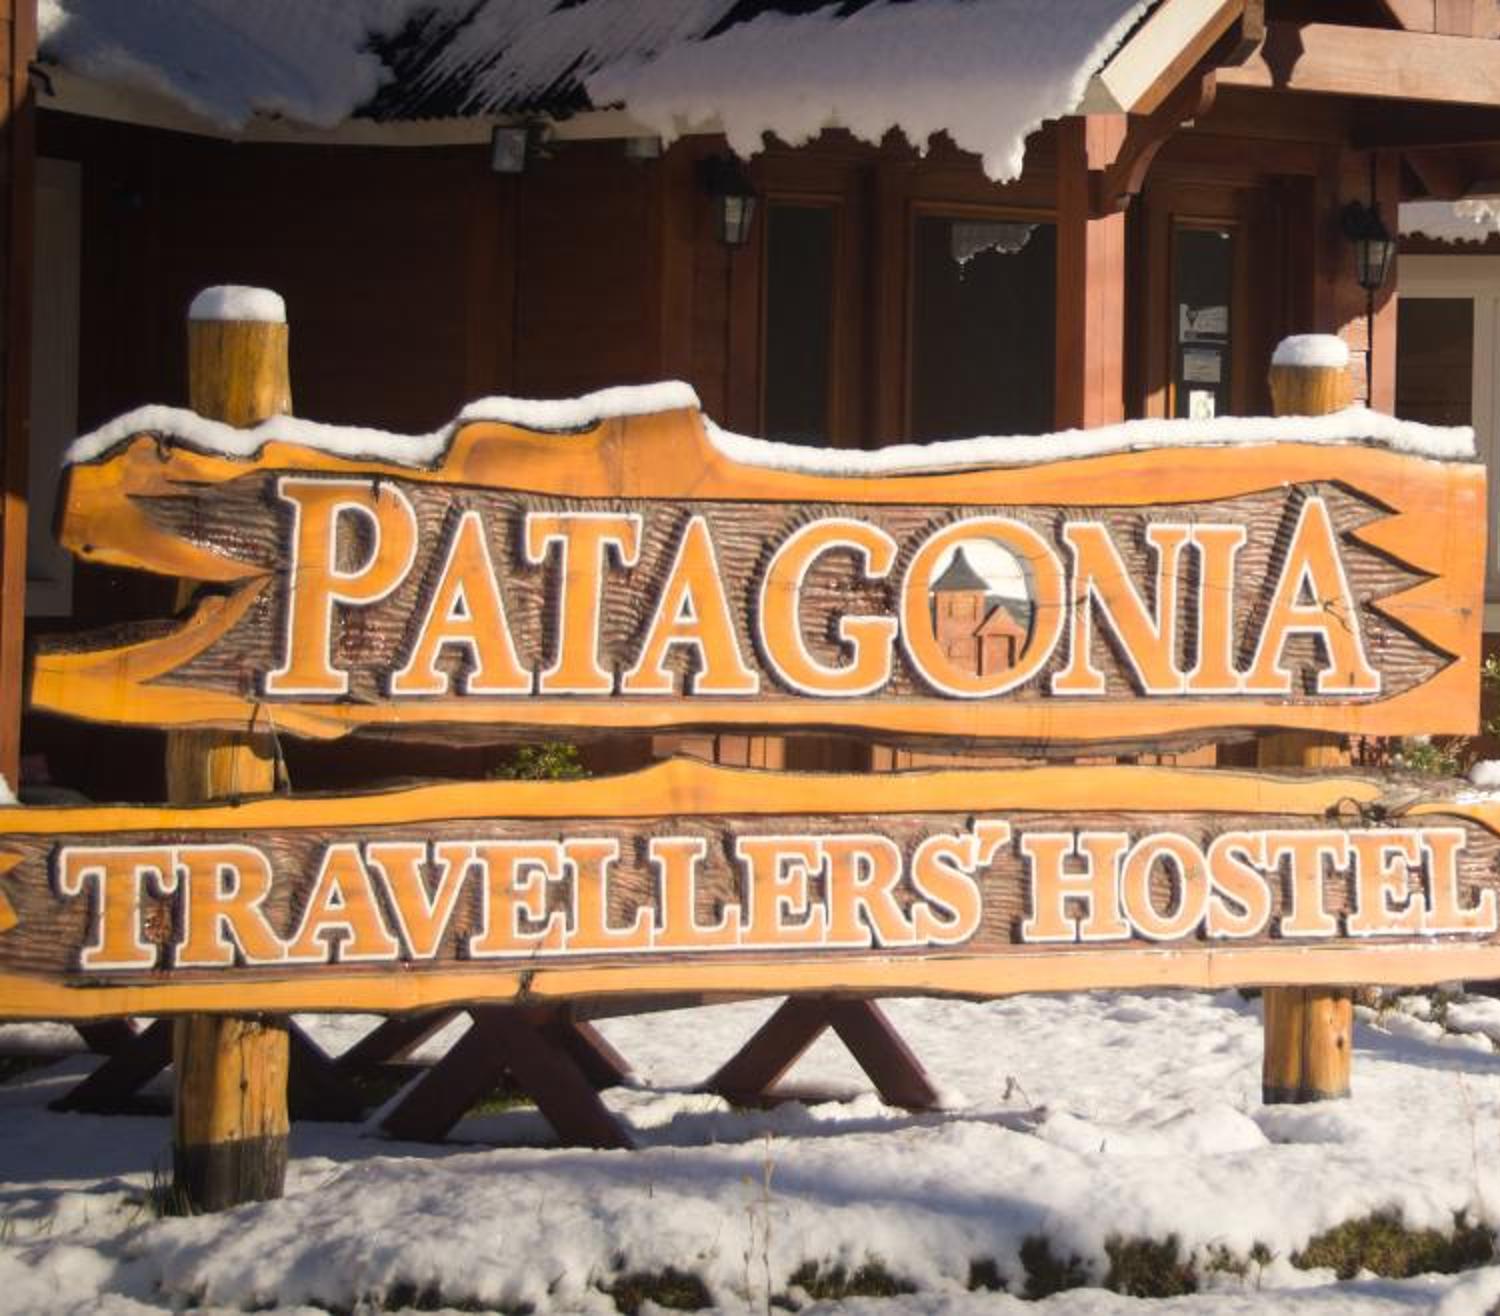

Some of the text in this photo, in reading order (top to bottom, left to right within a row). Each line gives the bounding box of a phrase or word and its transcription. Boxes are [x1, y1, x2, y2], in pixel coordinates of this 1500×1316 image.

[266, 477, 1382, 697] PATAGONIA
[59, 820, 1497, 971] TRAVELLERS' HOSTEL
